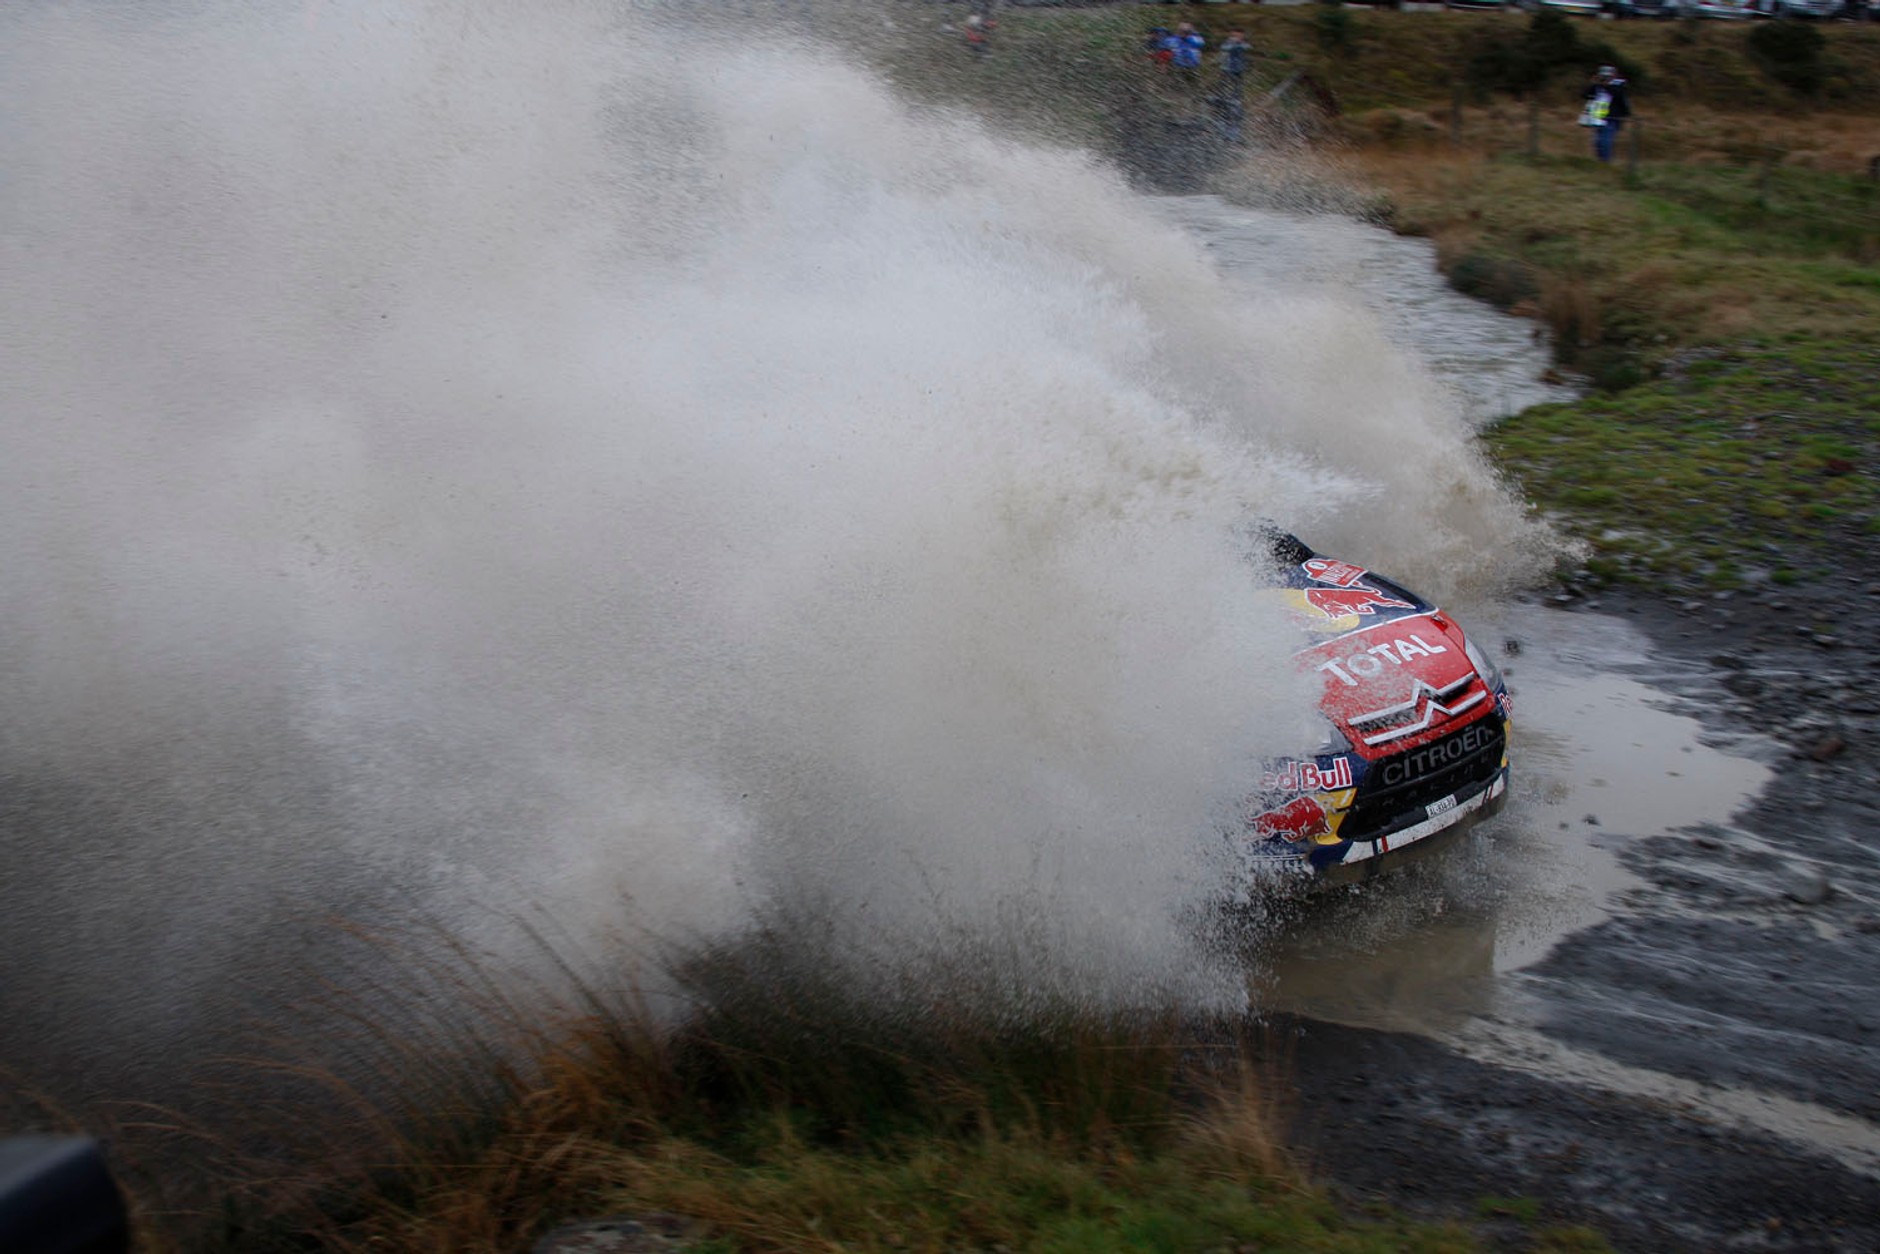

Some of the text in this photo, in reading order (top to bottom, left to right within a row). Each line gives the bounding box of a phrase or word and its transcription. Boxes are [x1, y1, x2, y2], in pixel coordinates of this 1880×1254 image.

[1316, 634, 1447, 686] TOTAL
[1259, 757, 1352, 791] ed Bull
